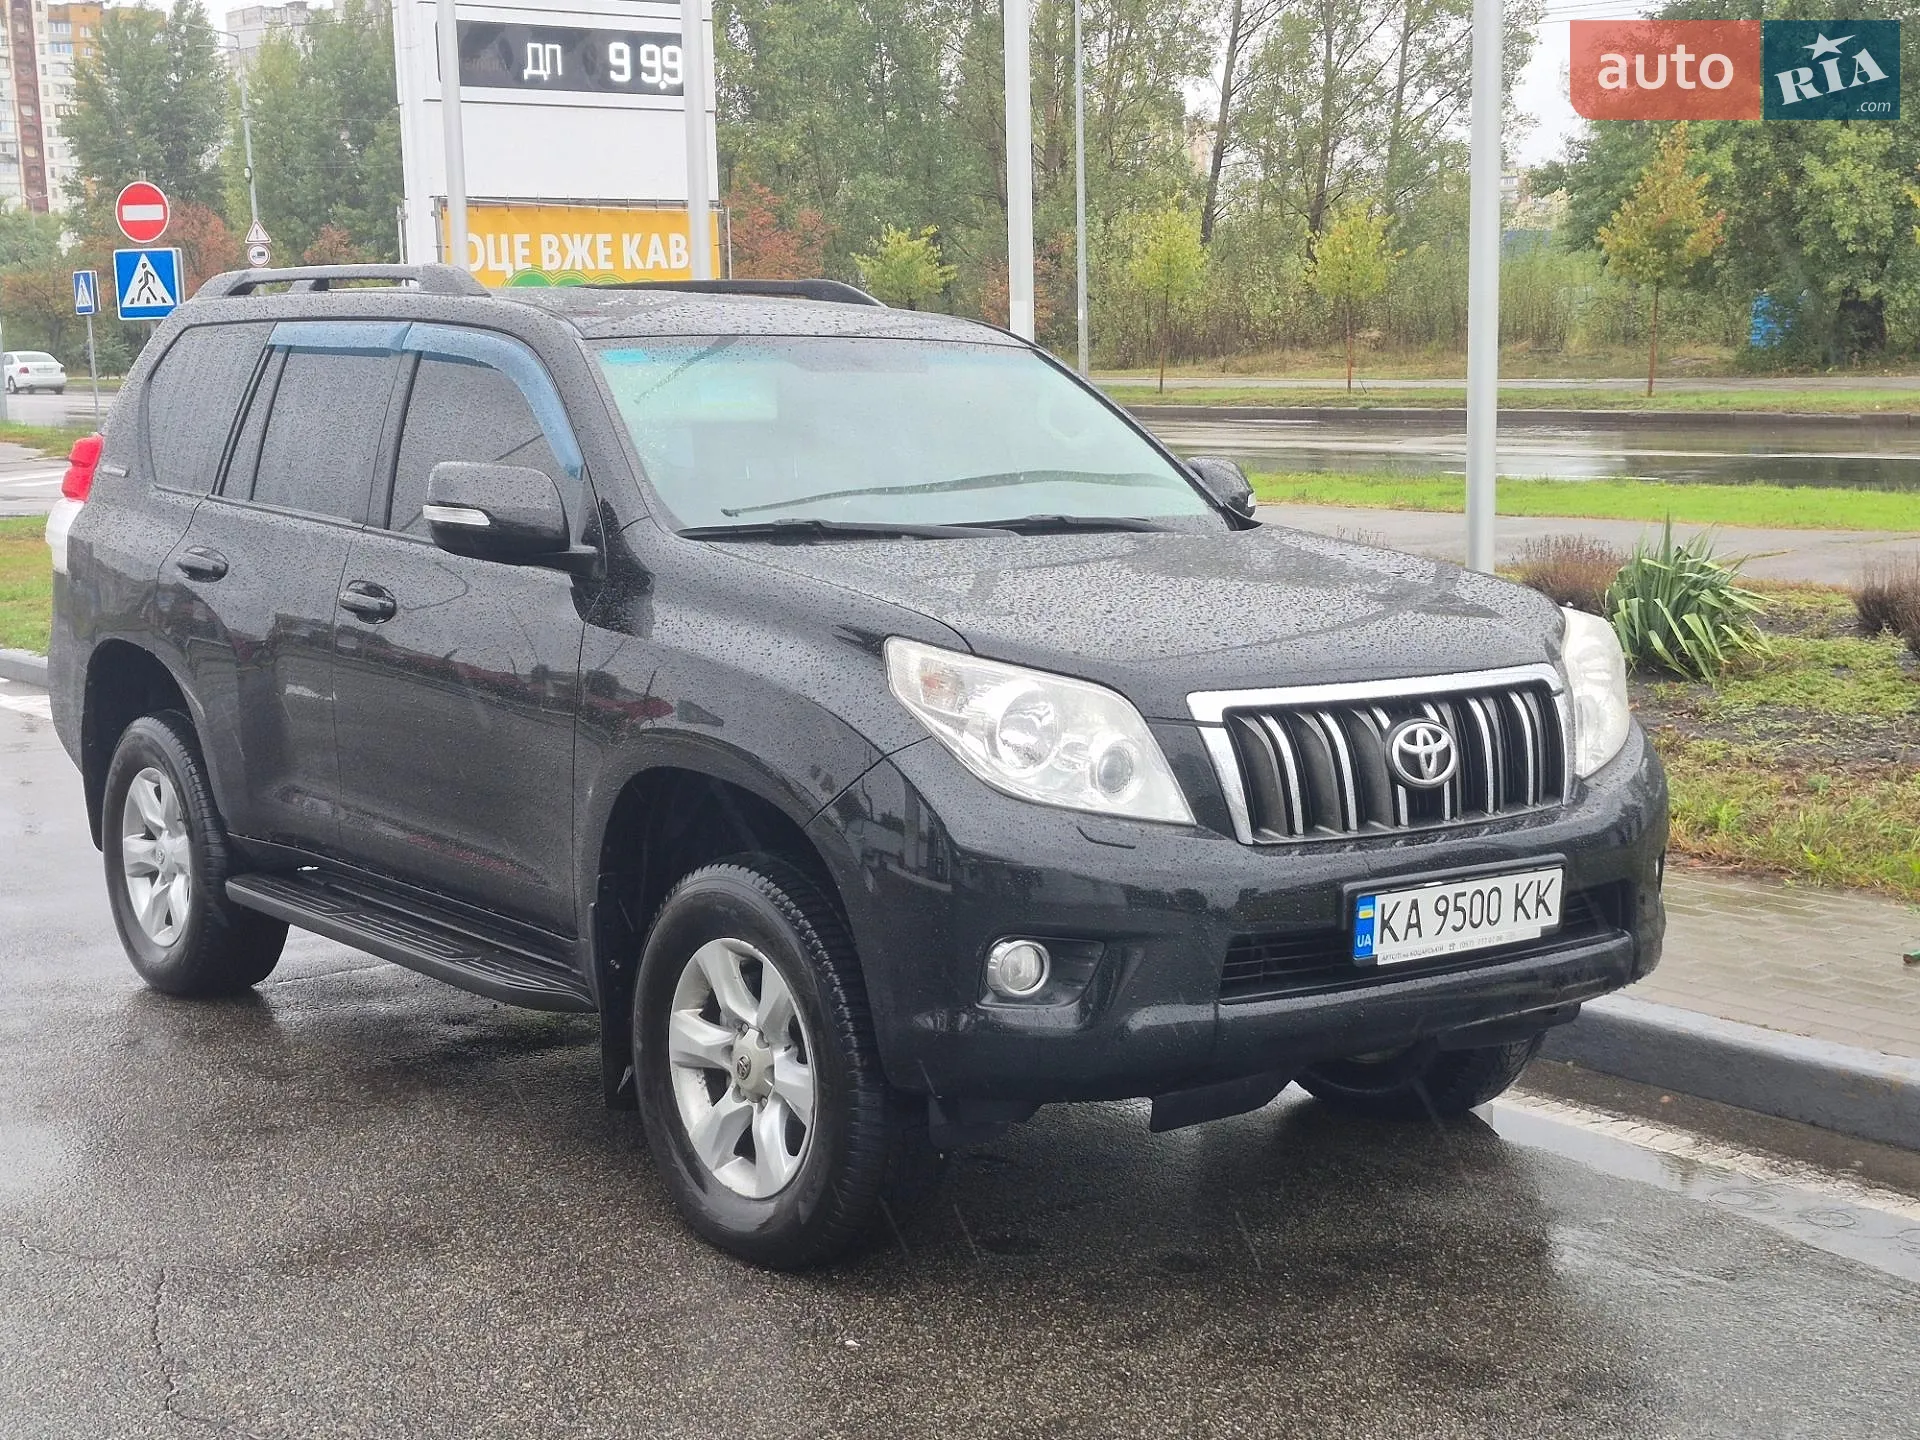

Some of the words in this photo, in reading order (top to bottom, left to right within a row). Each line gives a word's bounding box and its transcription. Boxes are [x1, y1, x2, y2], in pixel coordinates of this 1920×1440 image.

[523, 43, 562, 80] ДП
[540, 233, 614, 271] ВЖЕ
[622, 233, 692, 270] КАВ
[1379, 898, 1423, 945] KA
[1433, 886, 1502, 936] 9500
[1513, 877, 1555, 922] KK
[1357, 934, 1372, 948] UA
